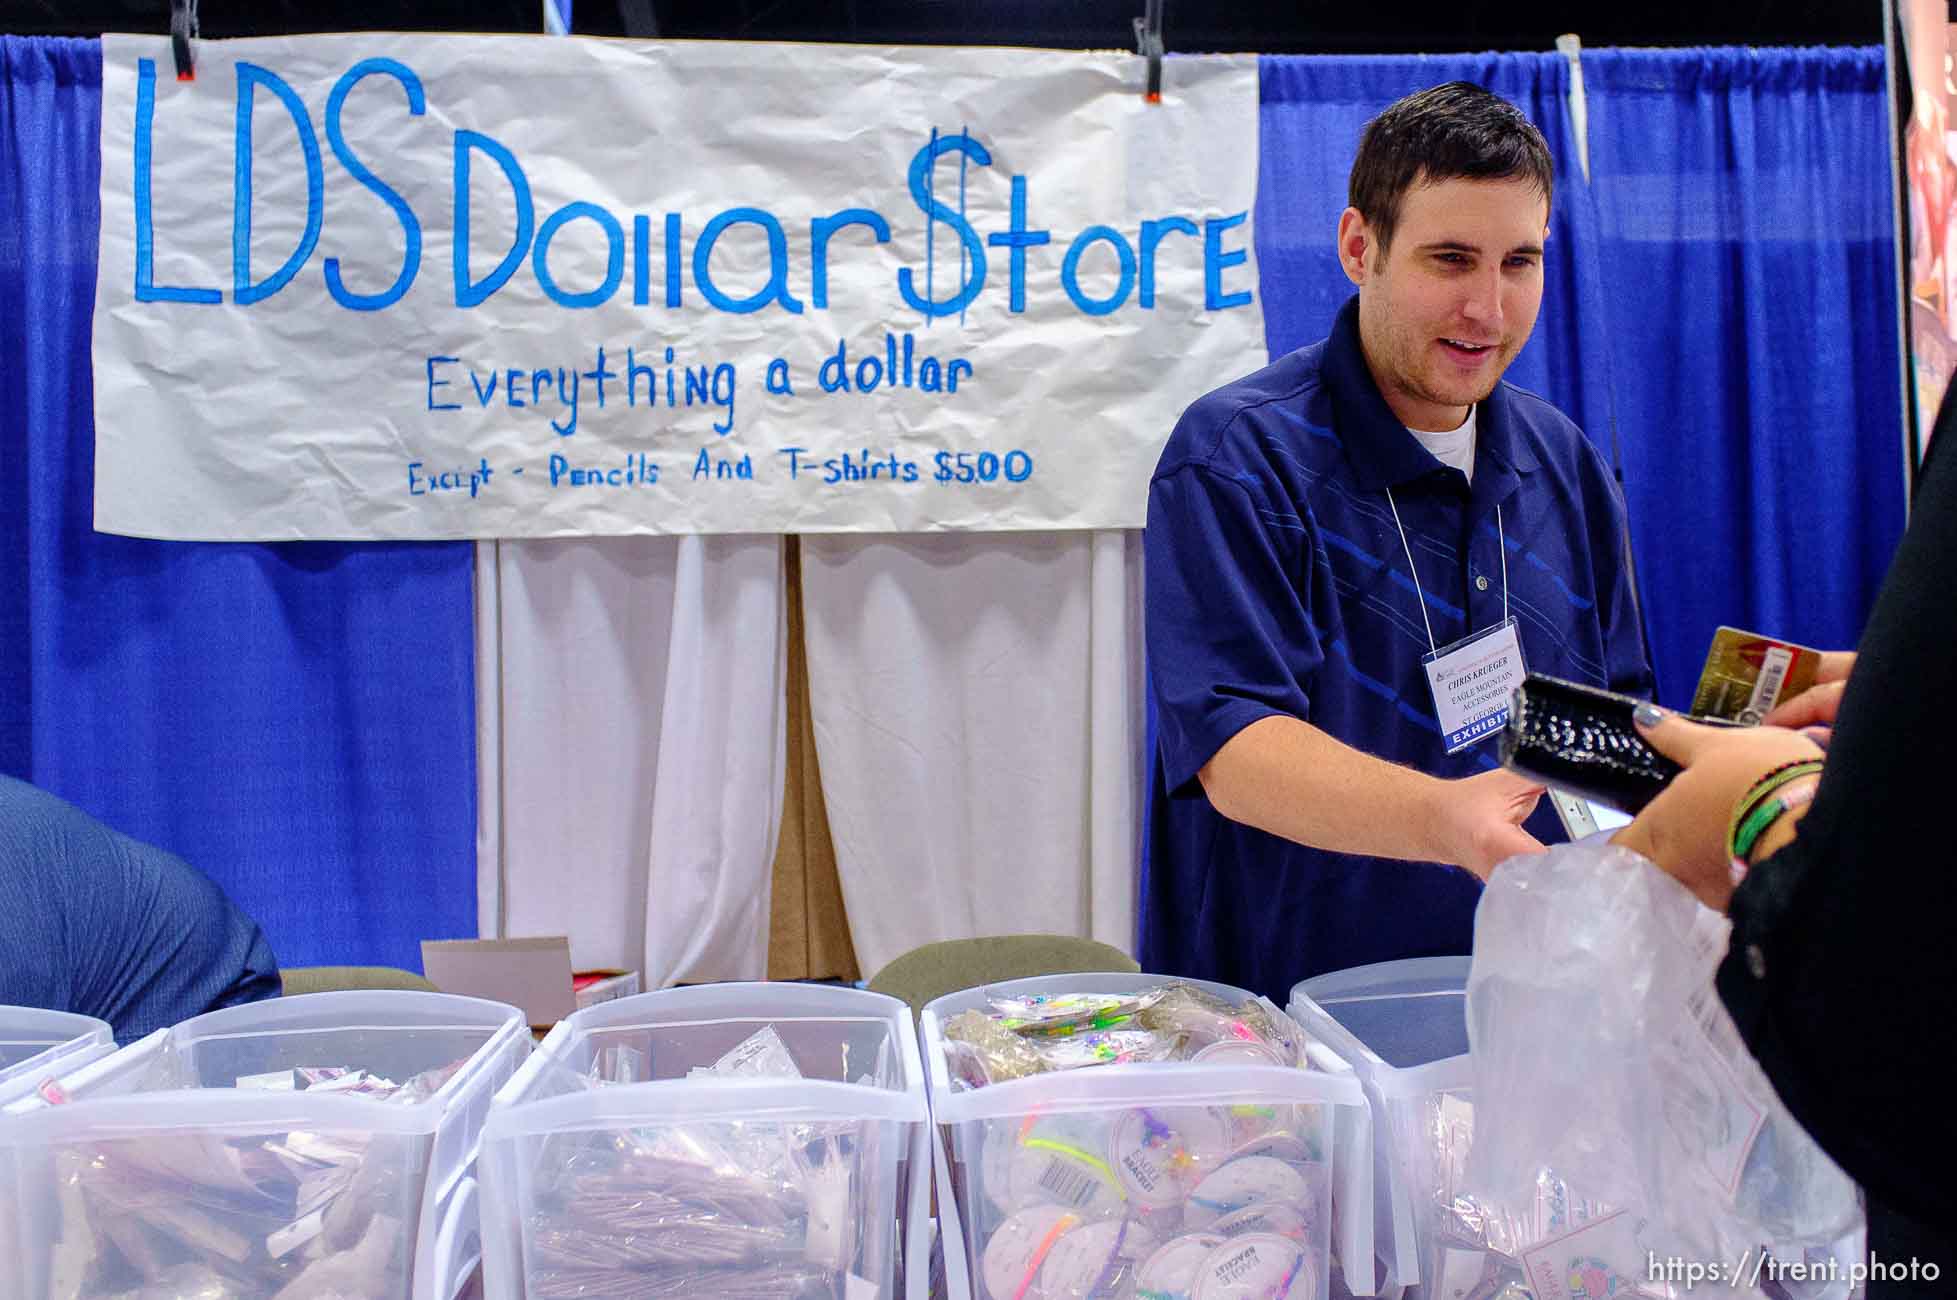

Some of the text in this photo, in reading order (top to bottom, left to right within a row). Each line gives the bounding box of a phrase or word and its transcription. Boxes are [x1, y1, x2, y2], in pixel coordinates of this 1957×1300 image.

[134, 57, 426, 312] LDS
[453, 129, 891, 314] Dollar
[766, 358, 793, 395] a
[818, 333, 973, 393] dollar
[692, 448, 753, 481] And
[778, 448, 919, 484] T-shirts
[934, 449, 1033, 486] $5.00
[1448, 674, 1472, 690] CHRIS
[1473, 656, 1509, 679] KRUEGER
[1451, 671, 1513, 704] EAGLE MOUNTAIN
